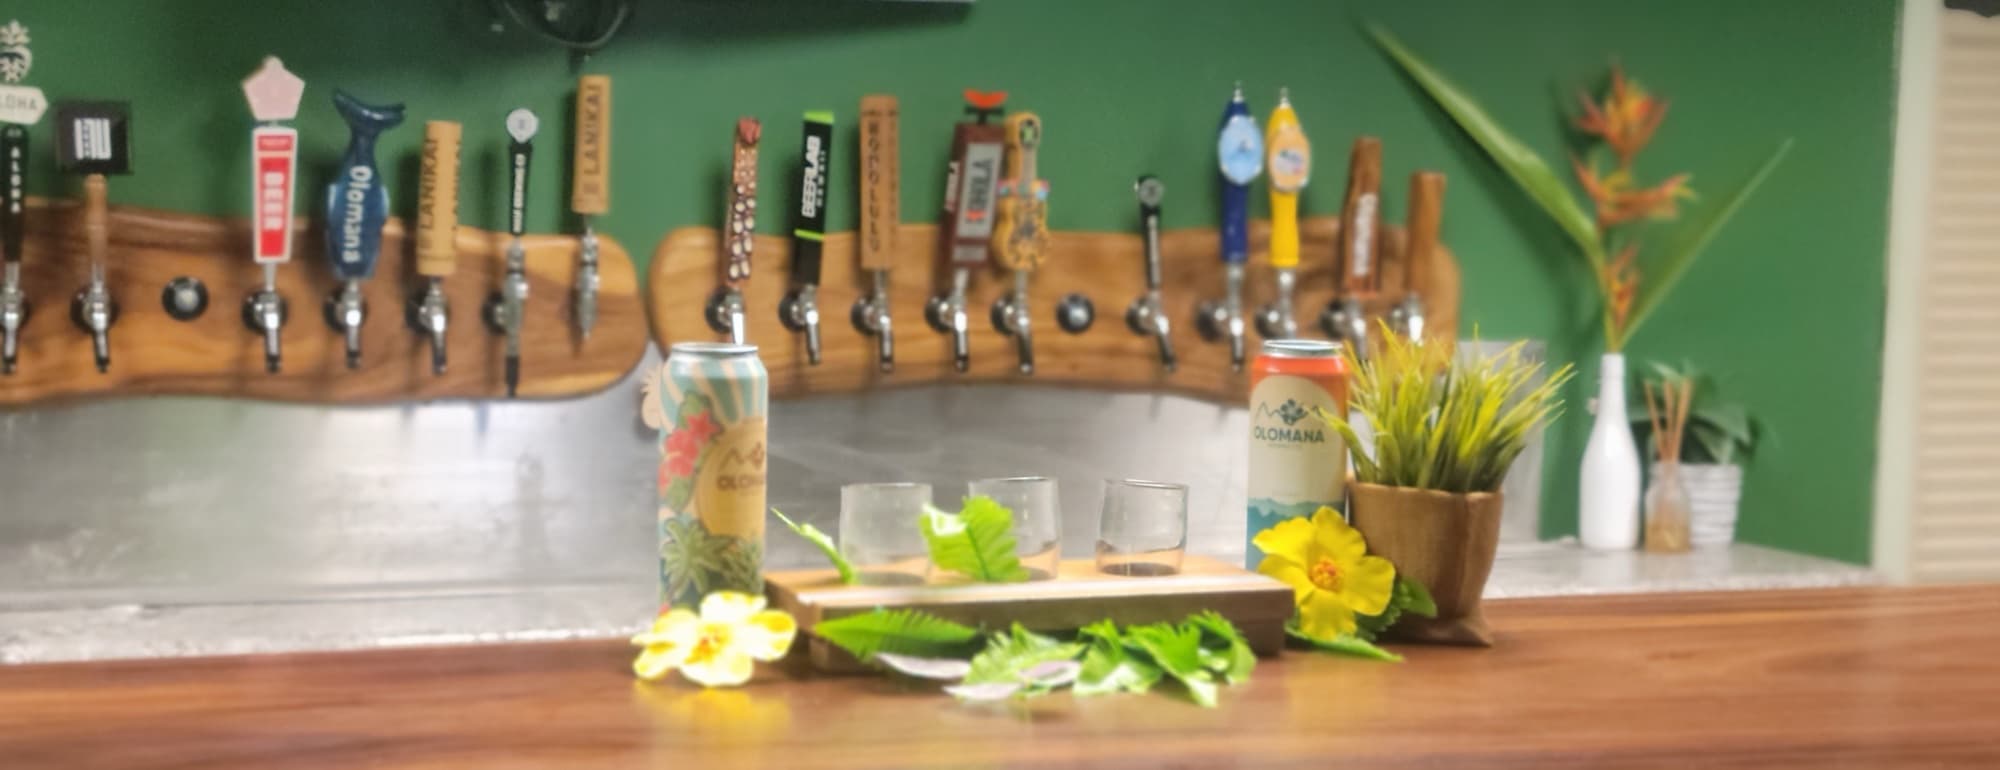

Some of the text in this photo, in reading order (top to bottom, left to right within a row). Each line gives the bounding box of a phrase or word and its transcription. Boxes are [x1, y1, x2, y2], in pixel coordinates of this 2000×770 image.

[583, 84, 602, 176] LANIKAI
[342, 165, 373, 263] Olomana
[419, 139, 438, 230] LANIKAI
[801, 135, 821, 218] BEERLAB
[1254, 426, 1325, 443] OLOMANA
